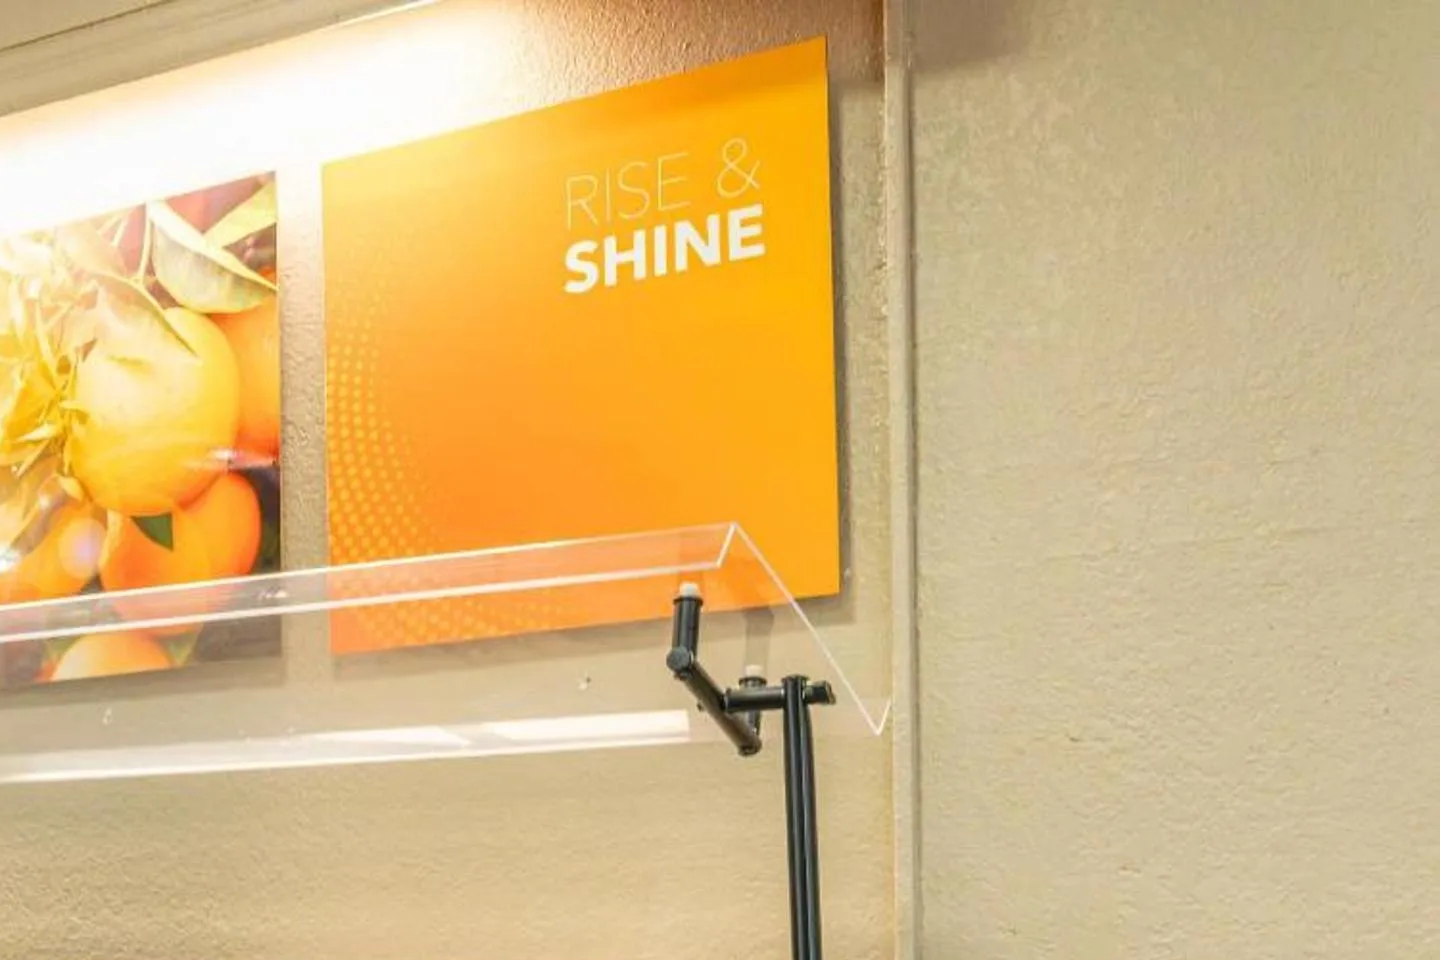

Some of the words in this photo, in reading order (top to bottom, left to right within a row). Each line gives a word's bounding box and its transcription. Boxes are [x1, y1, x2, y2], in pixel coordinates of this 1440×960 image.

[565, 152, 691, 229] RISE
[716, 137, 760, 198] &
[563, 203, 766, 294] SHINE
